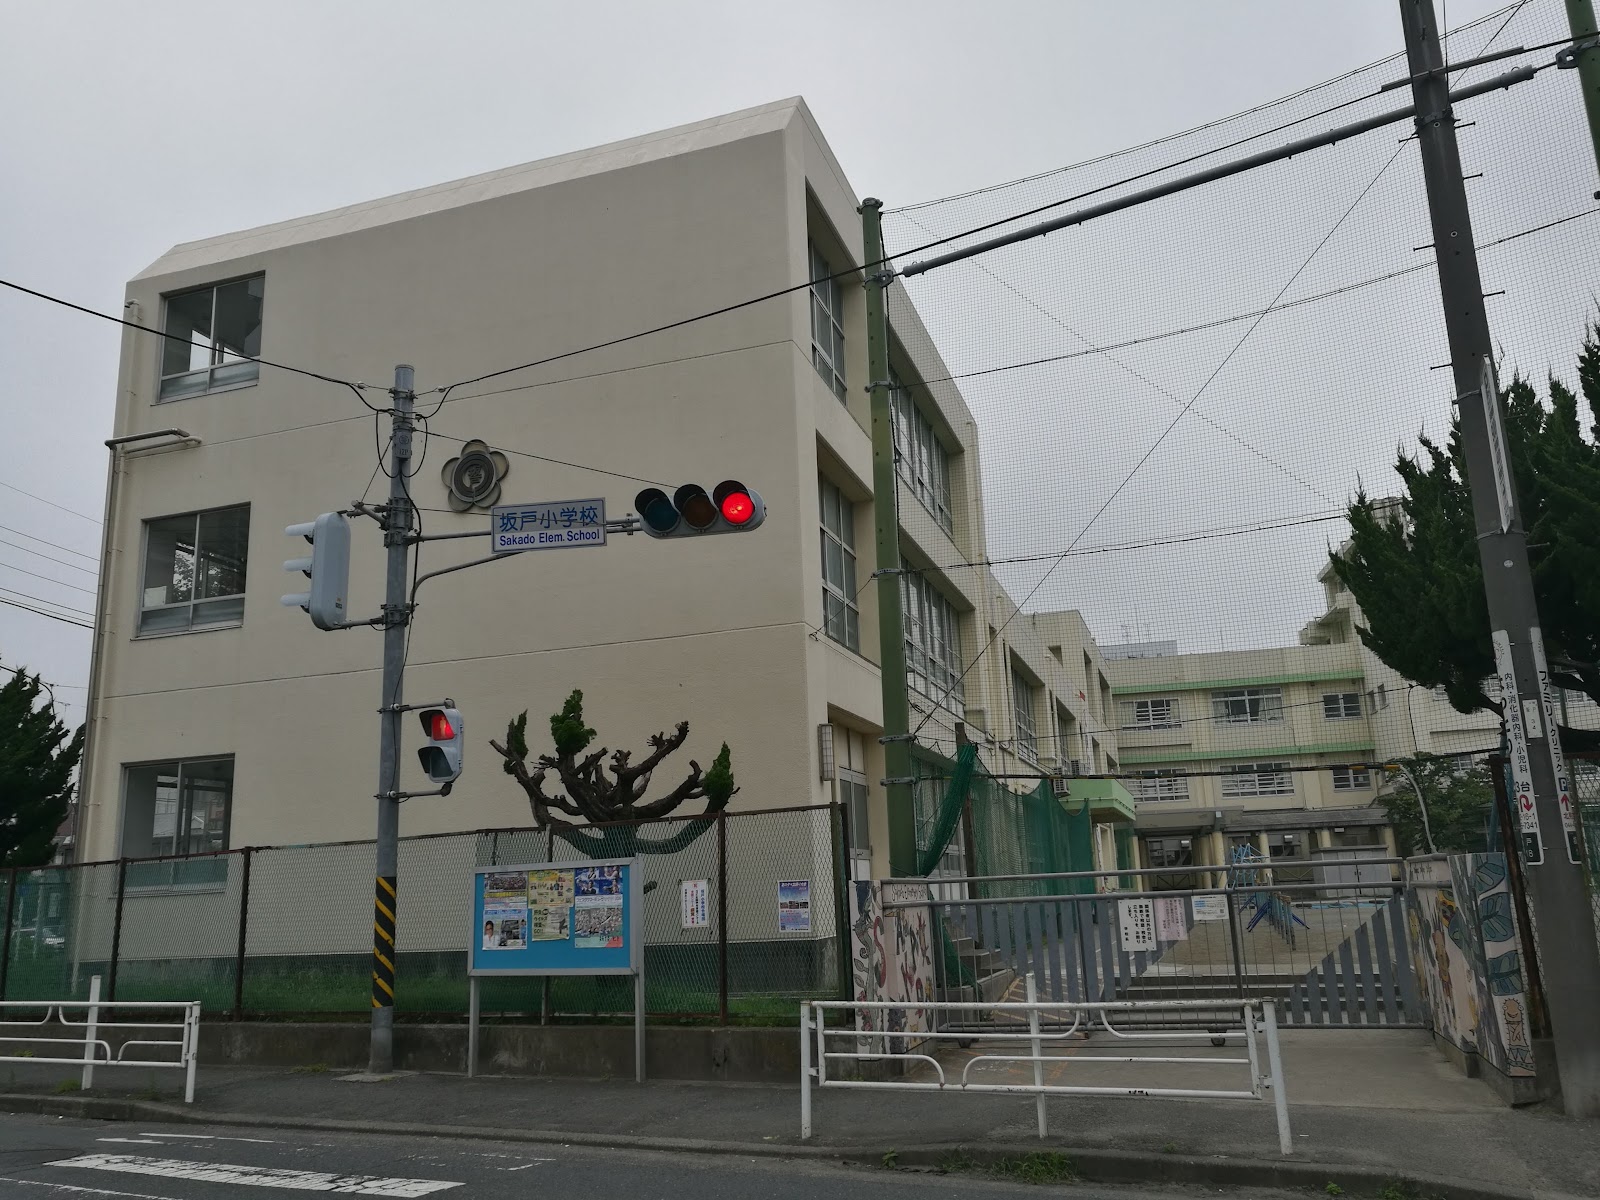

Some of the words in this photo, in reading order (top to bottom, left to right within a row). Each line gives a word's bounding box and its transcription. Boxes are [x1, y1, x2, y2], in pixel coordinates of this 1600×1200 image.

[499, 506, 598, 532] 坂戸小学校
[499, 534, 535, 546] Sakado
[538, 532, 565, 543] Elem.
[566, 528, 600, 541] School
